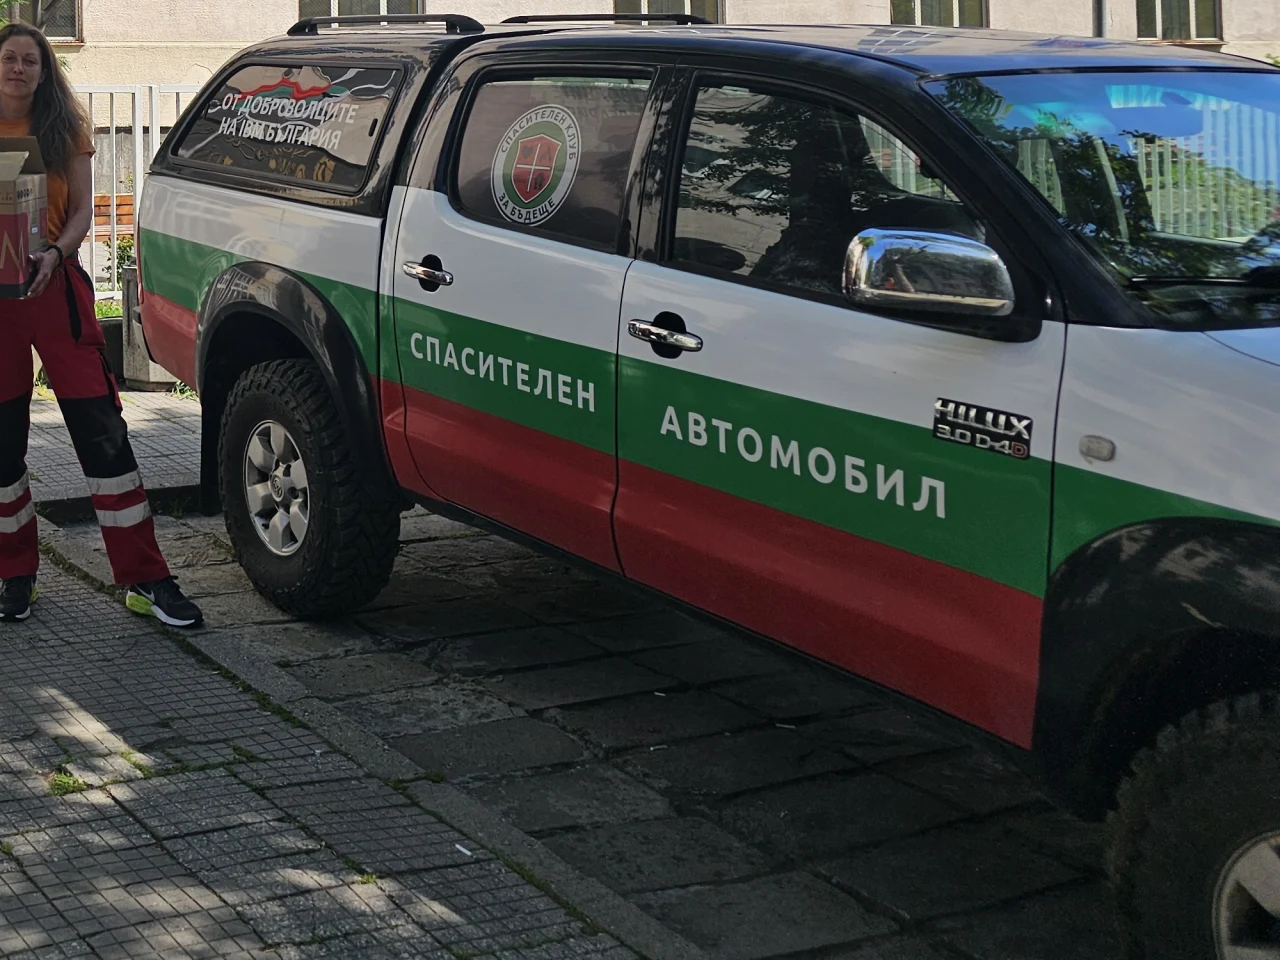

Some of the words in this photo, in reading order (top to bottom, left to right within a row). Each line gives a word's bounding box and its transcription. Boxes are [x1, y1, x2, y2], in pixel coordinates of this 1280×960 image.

[221, 92, 243, 111] ОТ
[238, 94, 360, 125] ДОБРОВОЛЦИТЕ
[220, 116, 237, 136] НА
[264, 124, 343, 150] БЪЛГАРИЯ
[501, 109, 567, 154] СПАСИТЕЛЕН
[564, 123, 577, 160] КЛУБ
[498, 192, 509, 210] ЗА
[509, 197, 556, 223] БЪДЕЩЕ
[410, 332, 596, 413] СПАСИТЕЛЕН
[934, 399, 1032, 440] HILUX
[936, 423, 972, 444] 3.0
[975, 433, 1028, 458] D-4D
[660, 404, 947, 519] АВТОМОБИЛ
